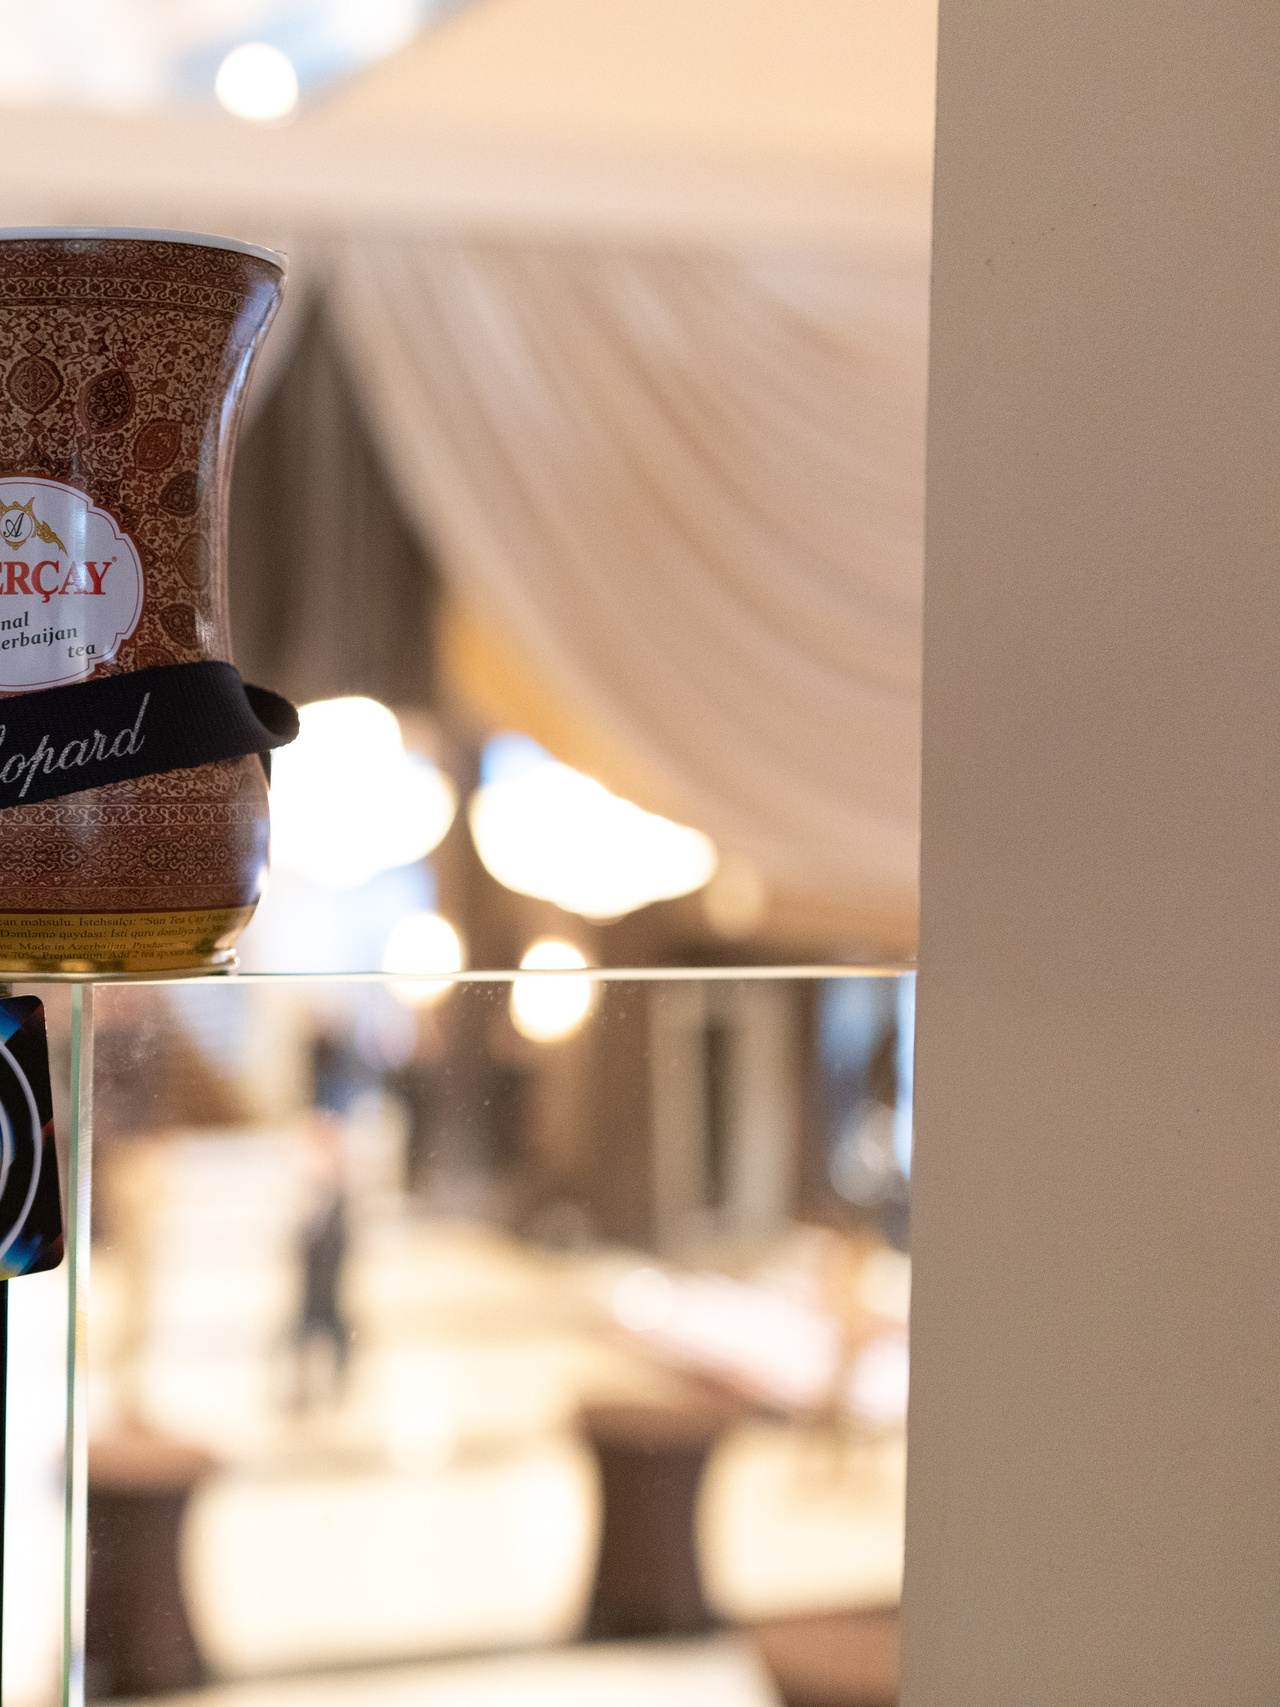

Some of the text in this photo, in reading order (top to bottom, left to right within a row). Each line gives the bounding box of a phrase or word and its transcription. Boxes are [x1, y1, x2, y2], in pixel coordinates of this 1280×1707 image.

[67, 644, 97, 658] tea
[21, 918, 74, 927] məhsulu.
[108, 951, 130, 959] Add
